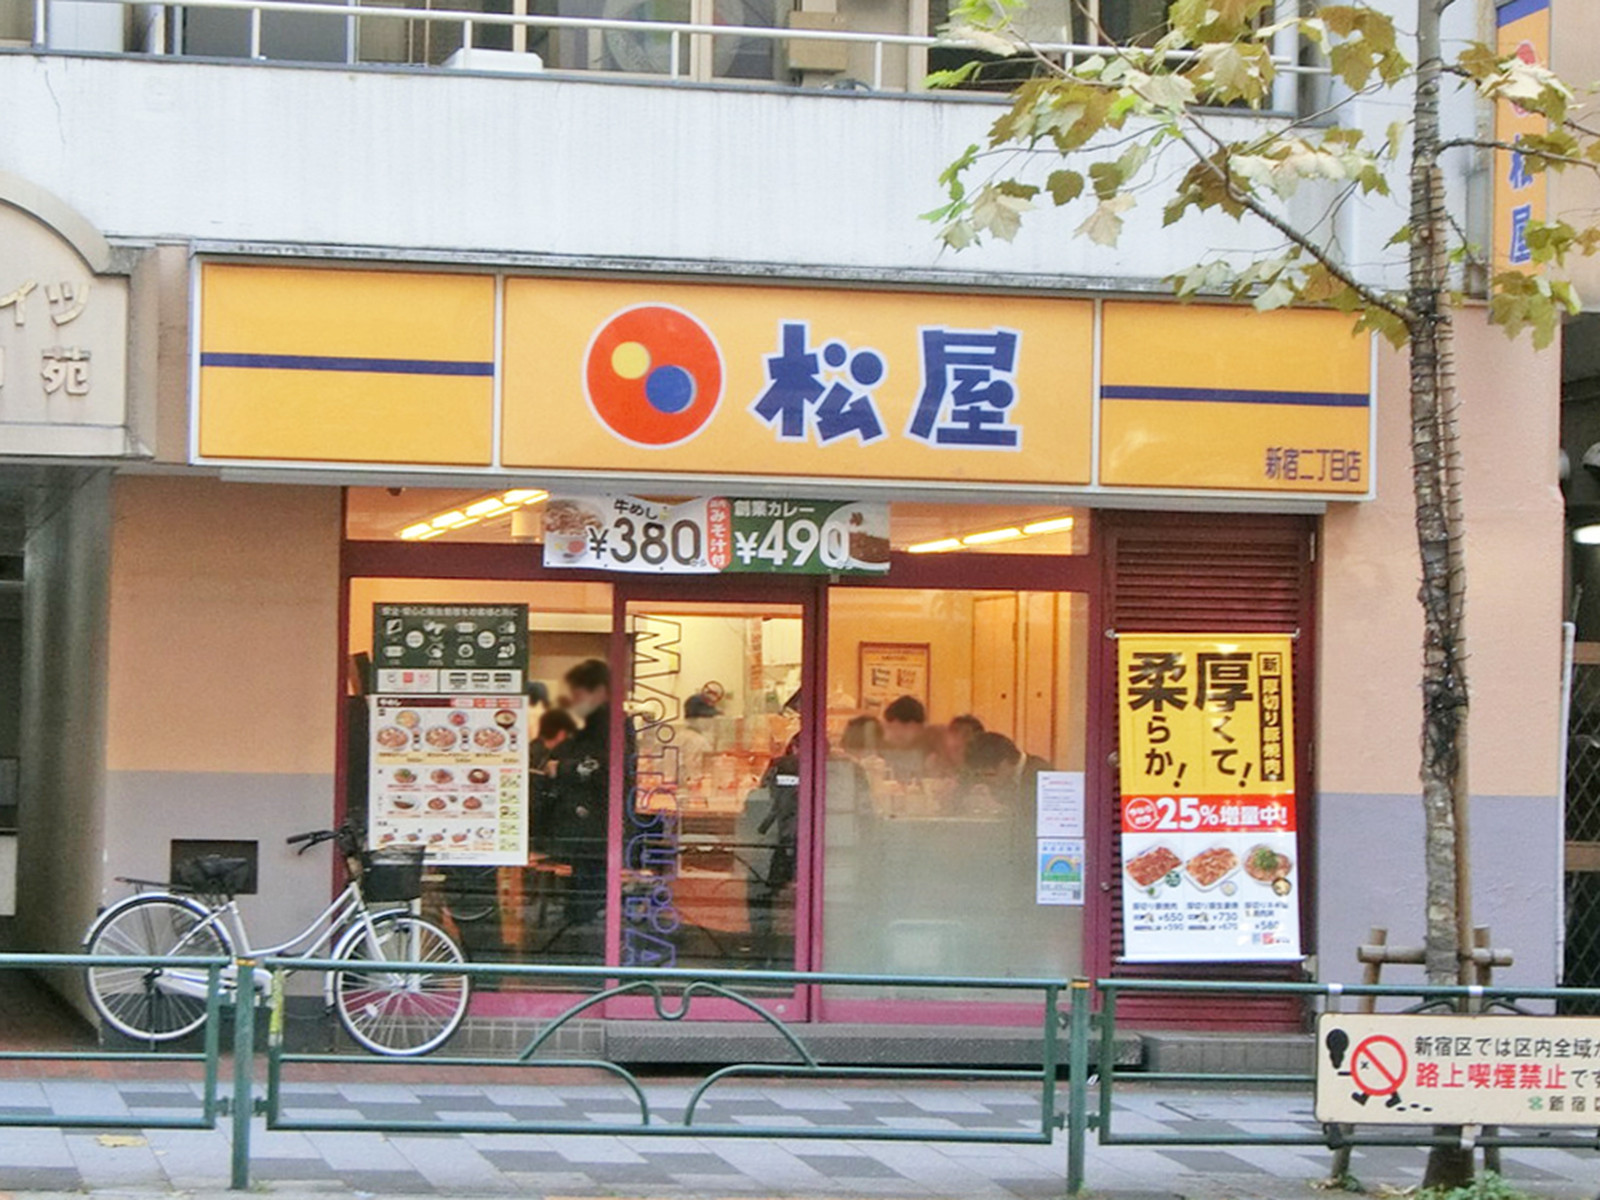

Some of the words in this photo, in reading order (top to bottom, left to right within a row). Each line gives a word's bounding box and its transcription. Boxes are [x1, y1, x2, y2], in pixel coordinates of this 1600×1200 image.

[750, 321, 1019, 448] 松屋
[1266, 446, 1361, 482] 新宿二丁目店
[614, 498, 658, 519] 牛めし
[734, 500, 815, 517] 創業カレー
[589, 517, 701, 566] ¥380
[734, 519, 850, 568] ¥490
